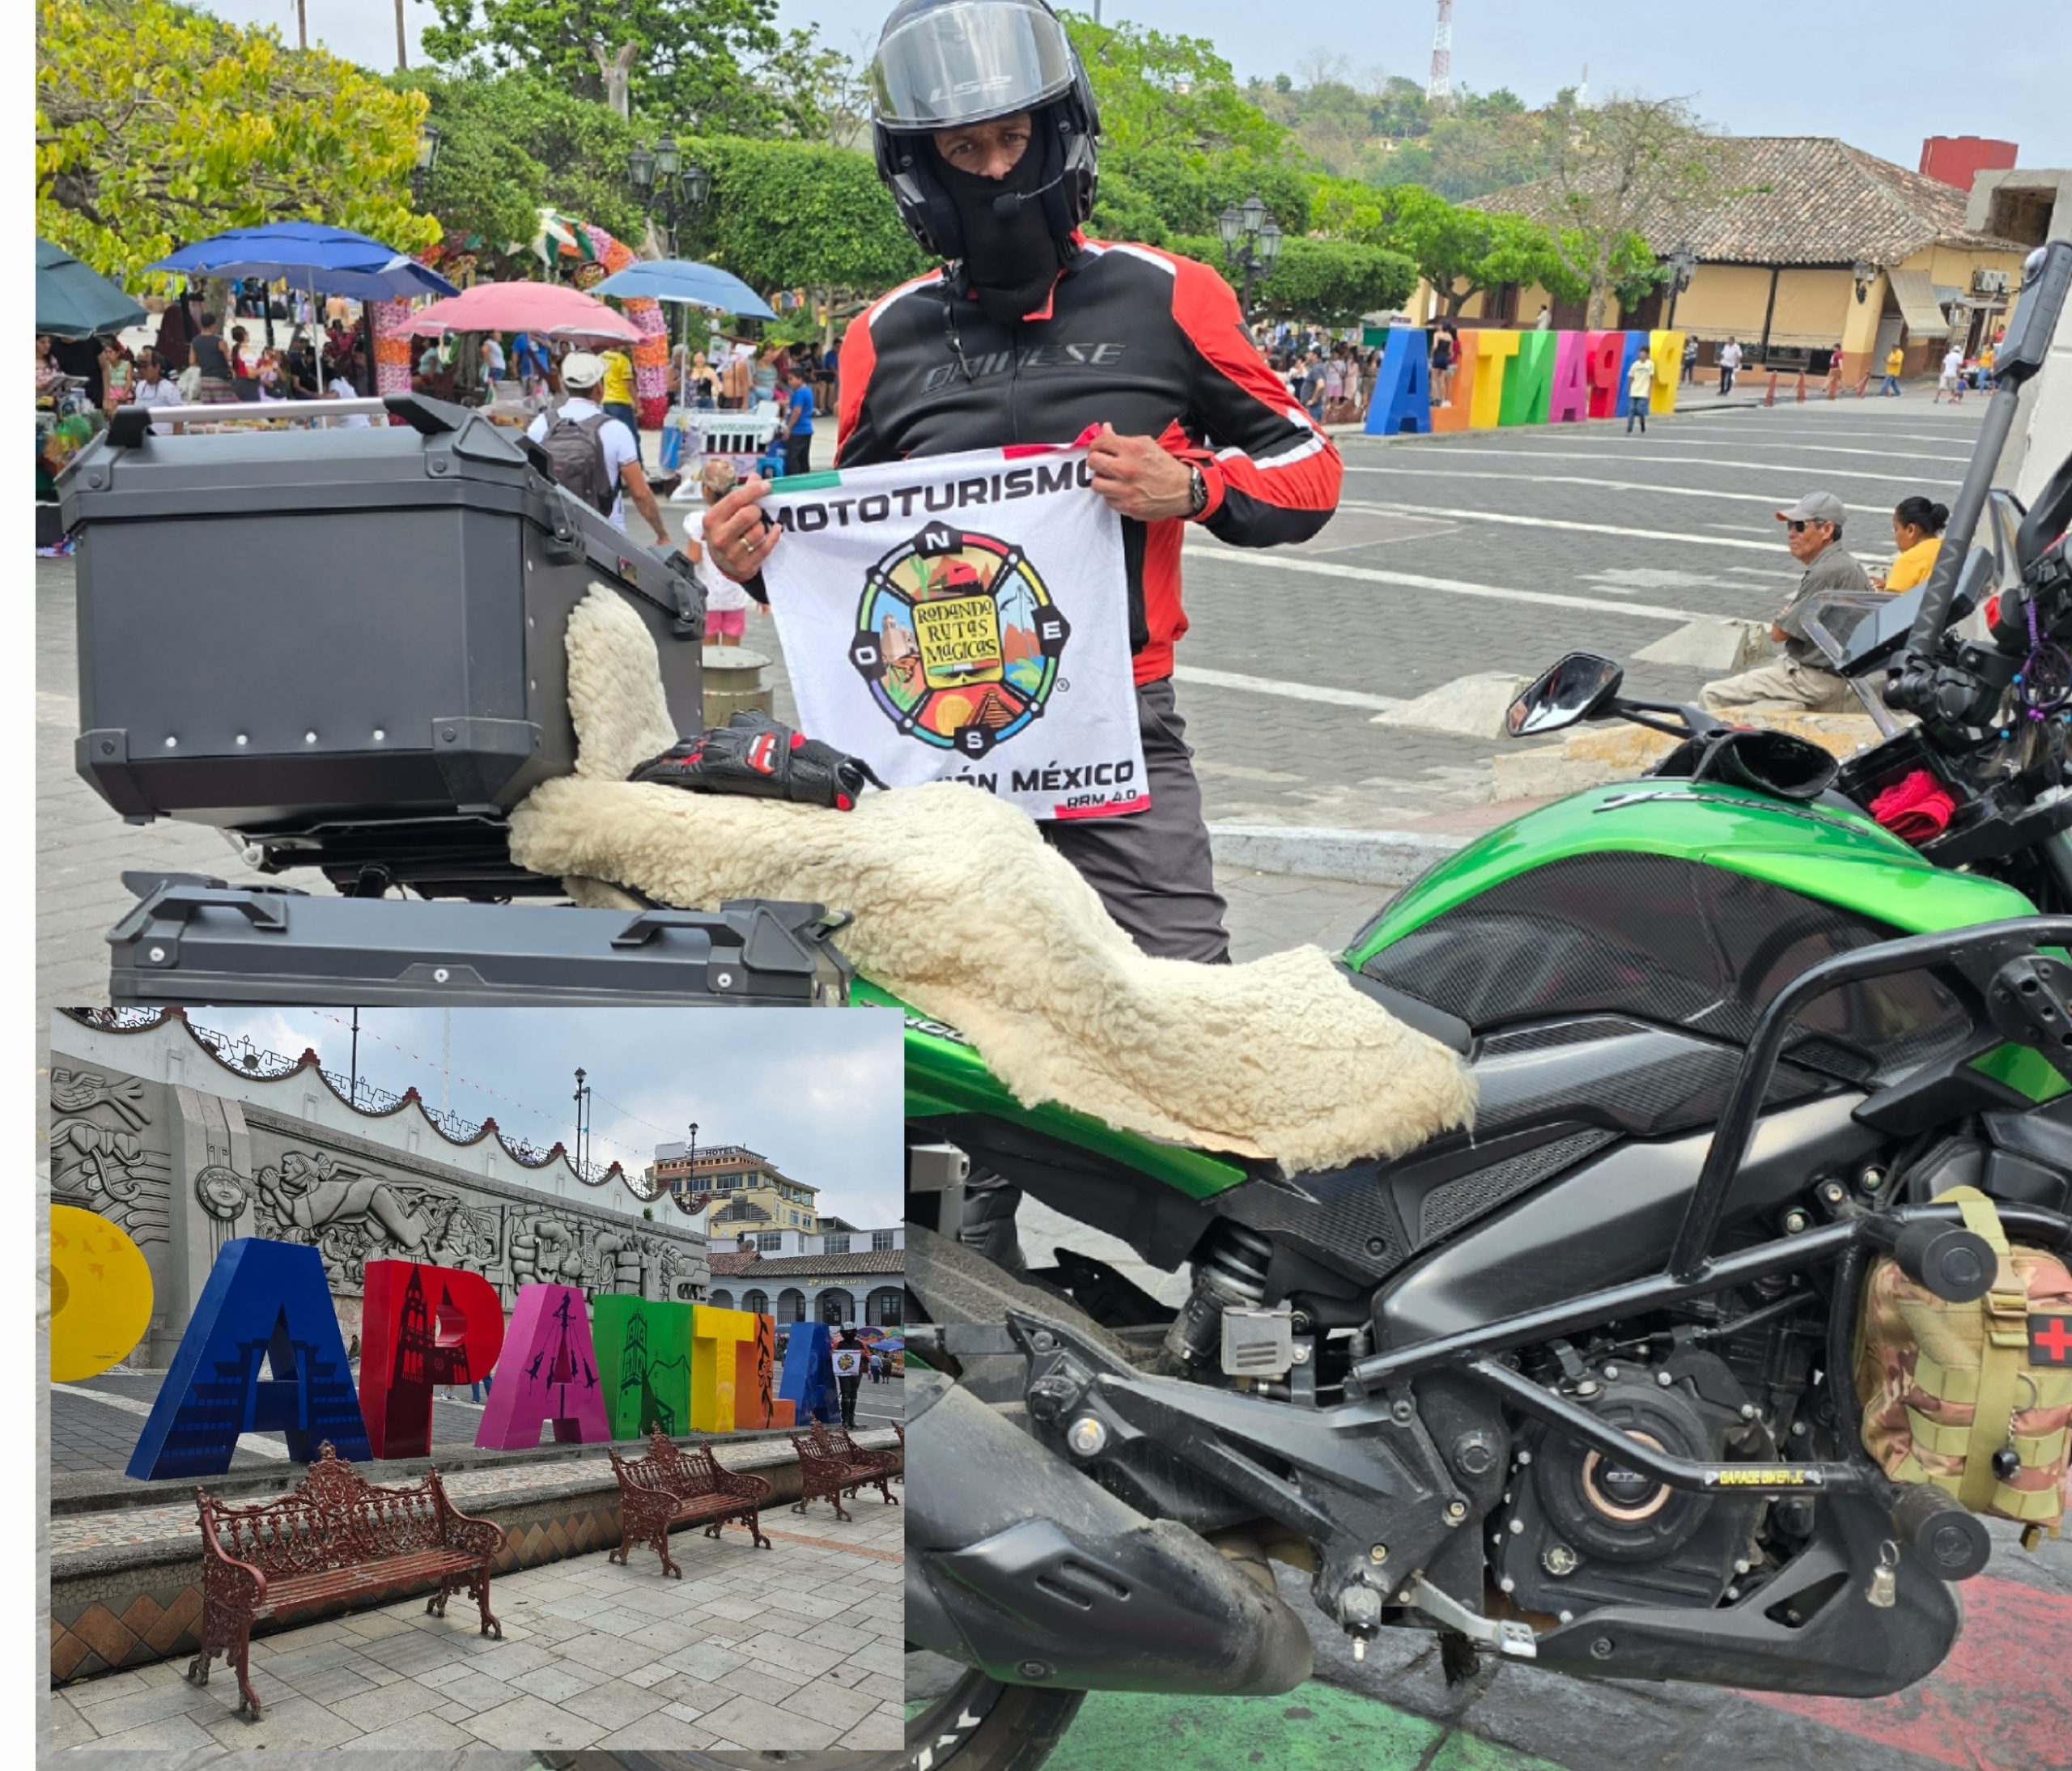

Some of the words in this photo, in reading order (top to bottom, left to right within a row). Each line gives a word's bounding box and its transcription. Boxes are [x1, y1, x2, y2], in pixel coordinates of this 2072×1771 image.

[925, 531, 950, 549] N
[1042, 620, 1062, 640] E
[856, 647, 877, 665] O
[965, 731, 983, 749] S
[1012, 760, 1134, 793] MÉXICO
[705, 1148, 735, 1157] HOTEL
